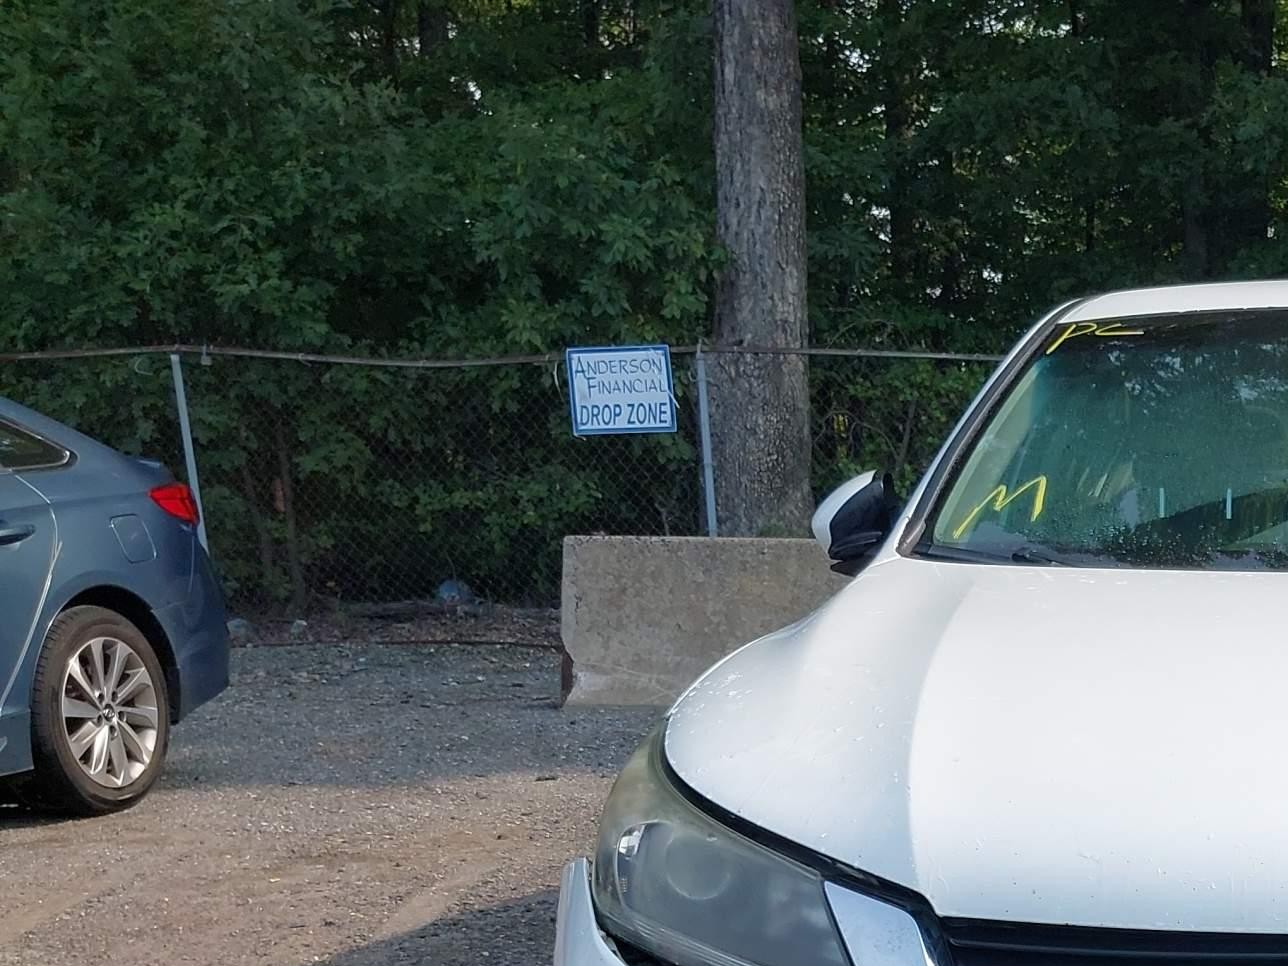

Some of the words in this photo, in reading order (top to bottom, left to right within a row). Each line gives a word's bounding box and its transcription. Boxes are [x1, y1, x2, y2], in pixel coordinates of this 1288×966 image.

[574, 356, 663, 378] ANDERSON
[587, 377, 668, 398] FINANCIAL
[580, 404, 622, 426] DROP
[627, 402, 668, 425] ZONE
